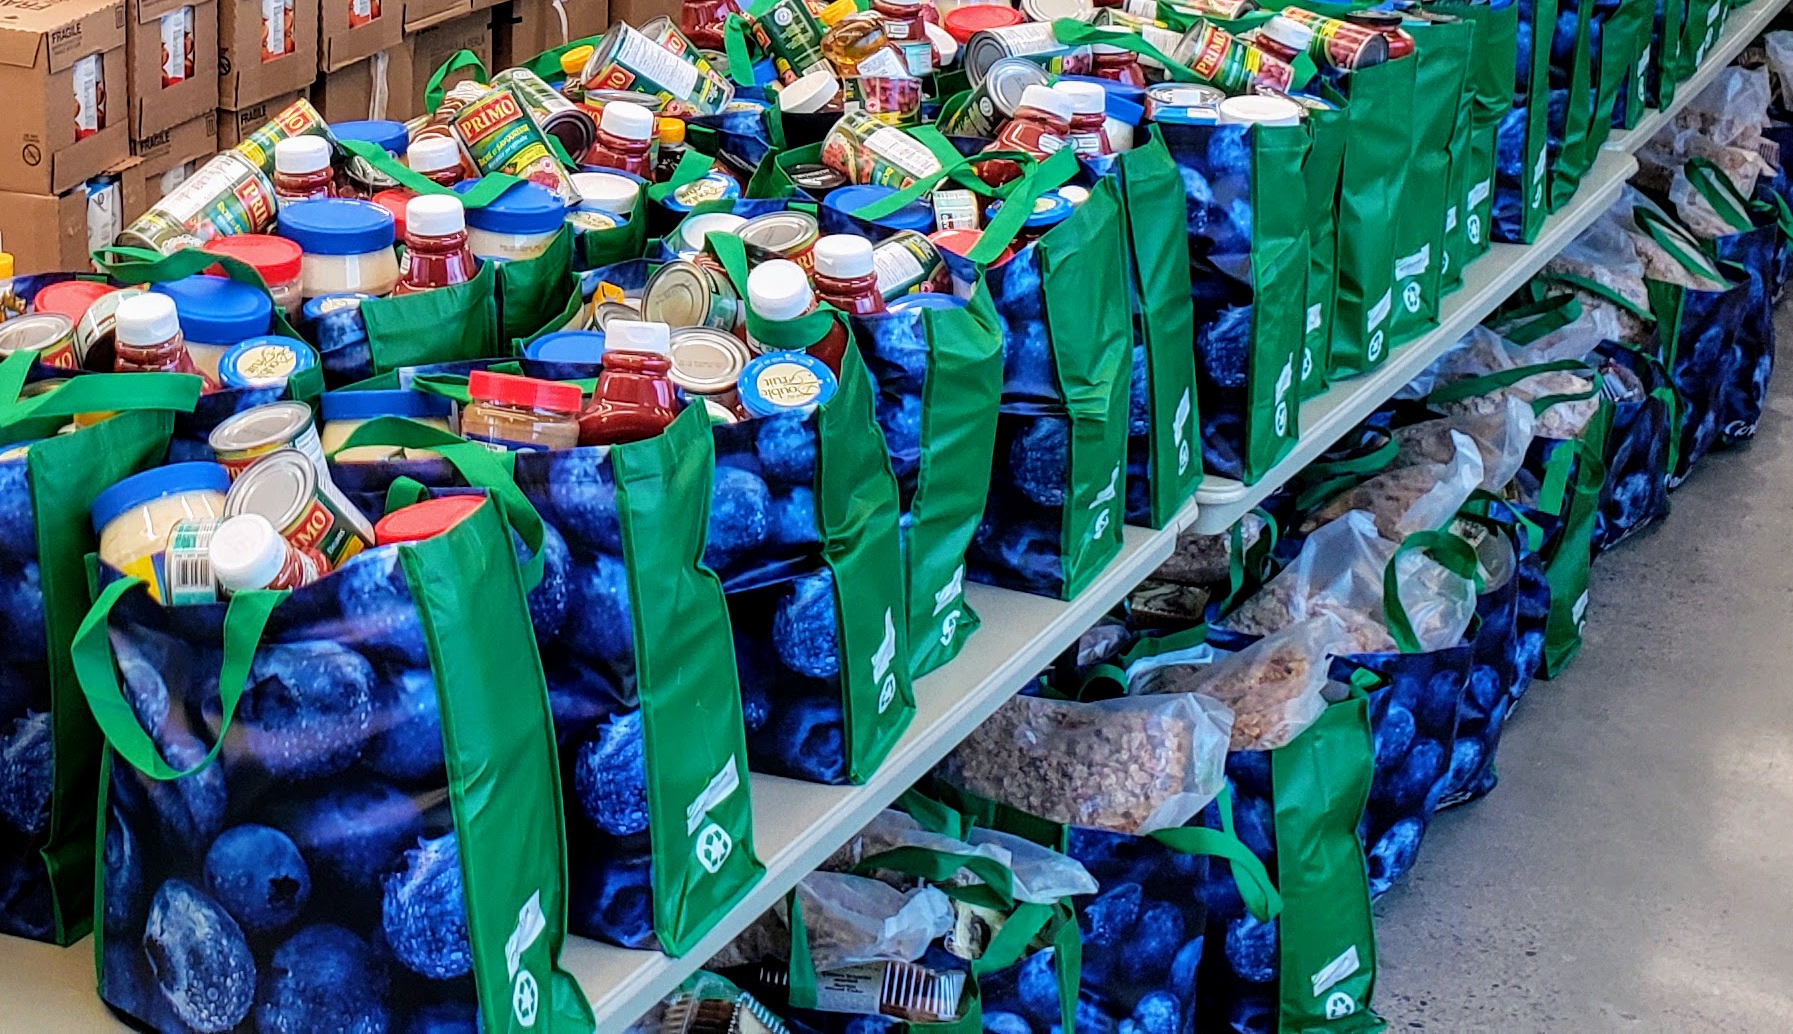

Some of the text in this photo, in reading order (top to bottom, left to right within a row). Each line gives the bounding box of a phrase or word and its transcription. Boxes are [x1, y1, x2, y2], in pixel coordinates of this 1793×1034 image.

[51, 22, 82, 44] FRAGILE
[1195, 31, 1227, 75] PRIMO
[461, 99, 515, 138] PRIMO
[291, 510, 326, 547] IMO
